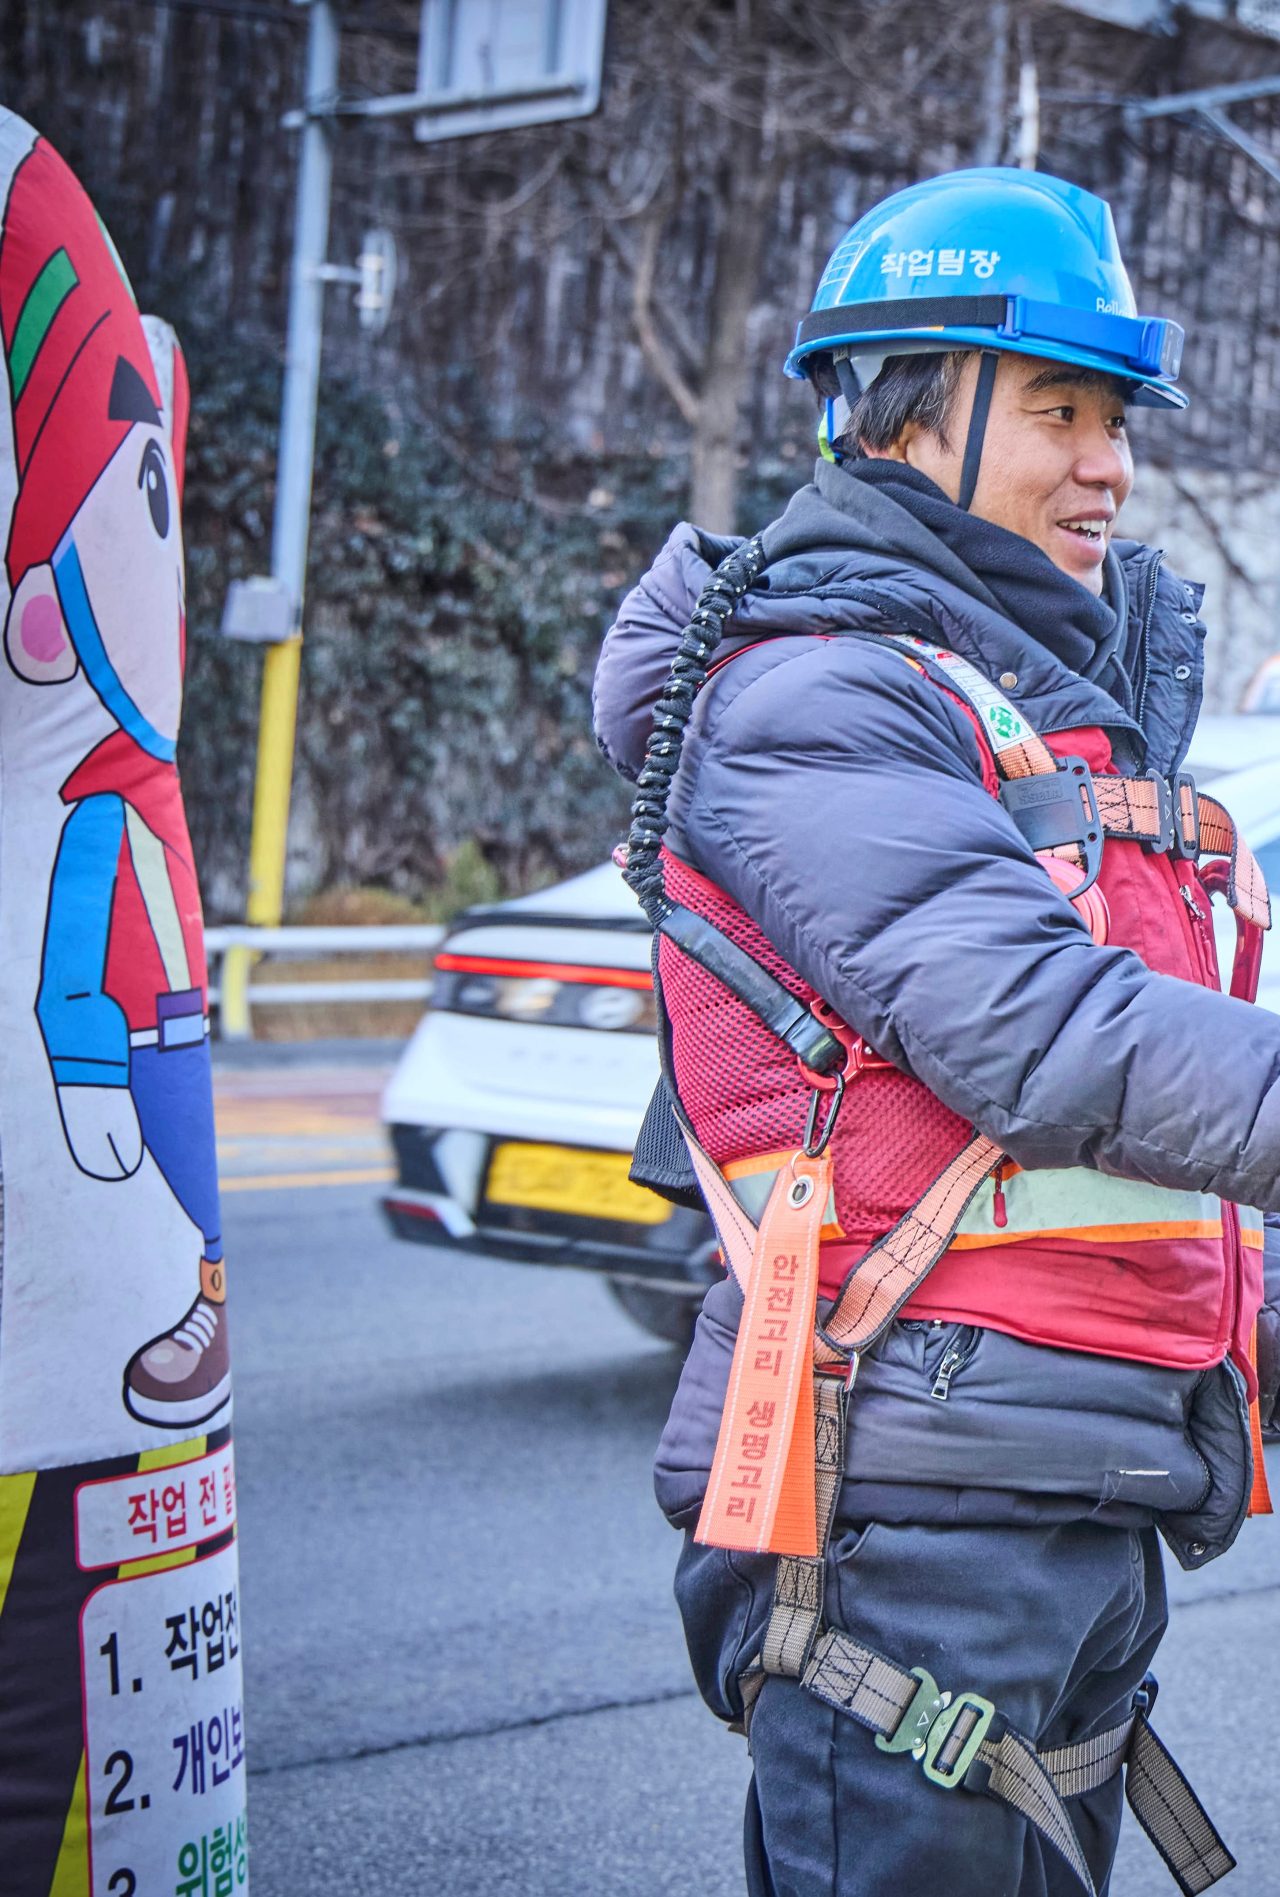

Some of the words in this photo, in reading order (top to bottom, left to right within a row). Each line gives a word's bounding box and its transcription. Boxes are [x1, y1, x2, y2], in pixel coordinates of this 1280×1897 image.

[880, 248, 1001, 279] 작업팀장
[754, 1254, 799, 1376] 안전고리
[726, 1401, 776, 1523] 생명고리
[128, 1481, 187, 1543] 작업
[199, 1471, 217, 1527] 전
[100, 1631, 143, 1696] 1.
[103, 1749, 150, 1816] 2.
